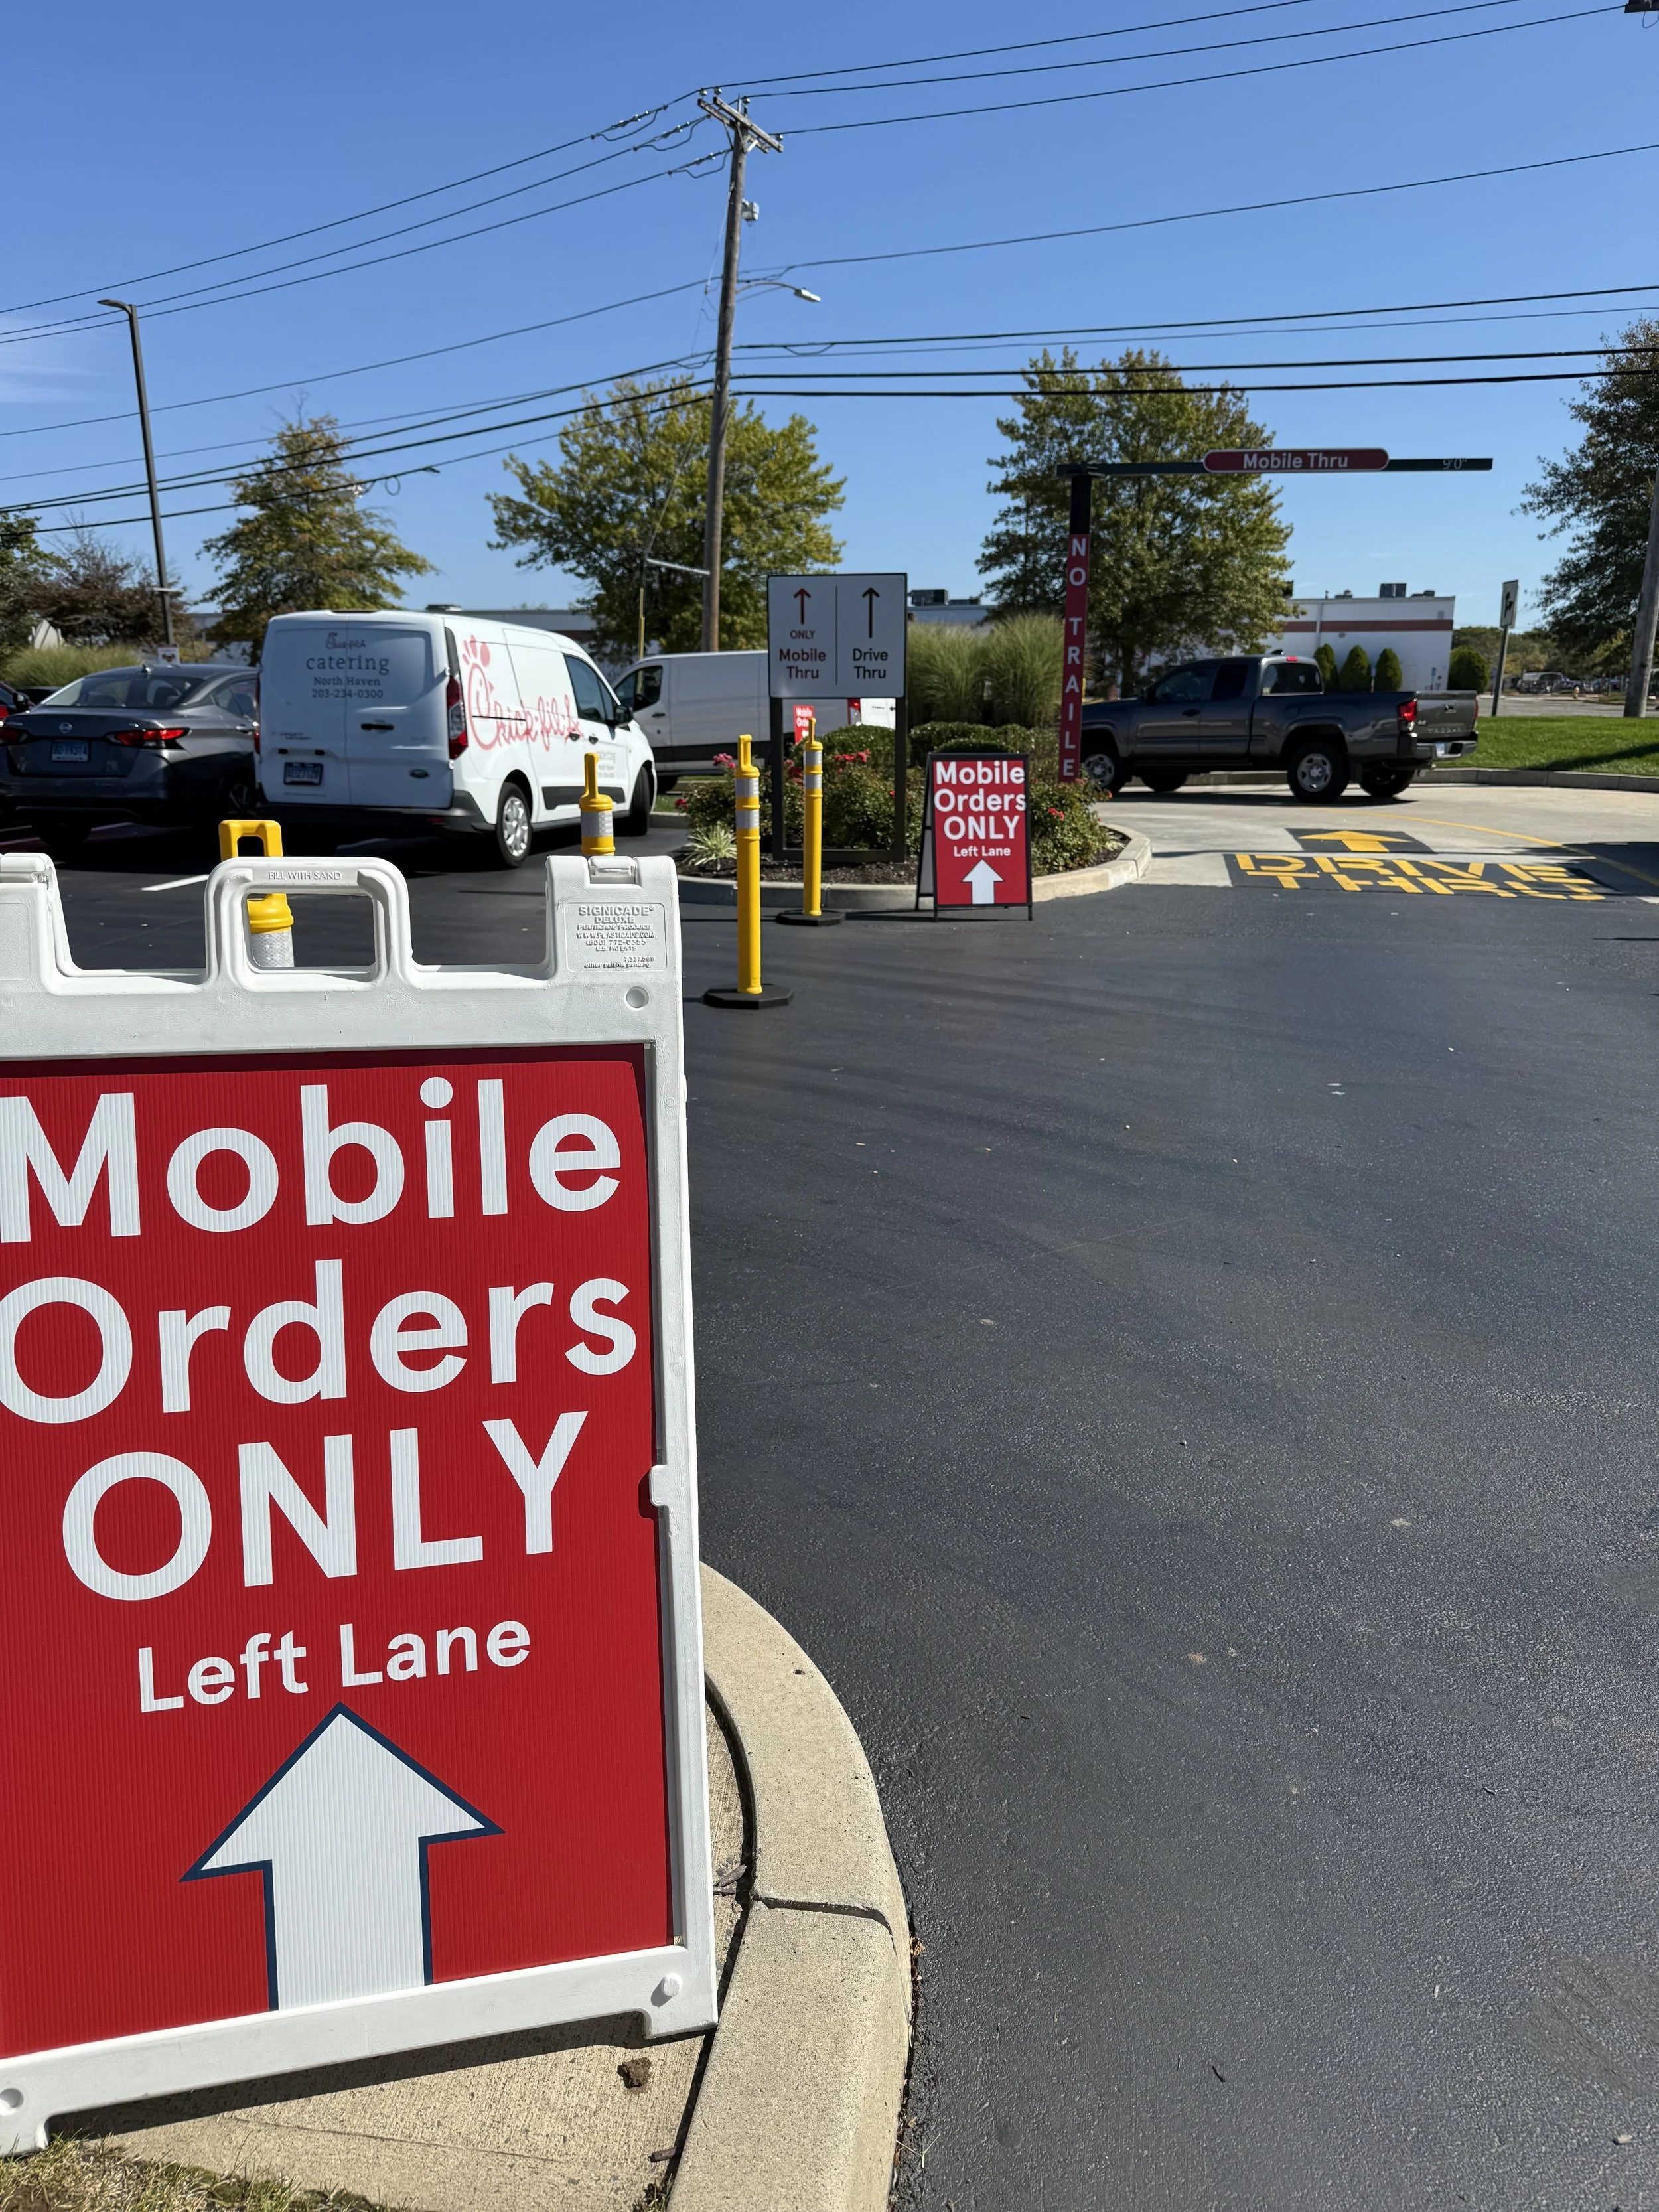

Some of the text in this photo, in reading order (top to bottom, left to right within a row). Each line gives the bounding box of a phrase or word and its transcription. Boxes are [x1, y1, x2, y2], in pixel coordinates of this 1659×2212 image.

[1243, 451, 1348, 470] Mobile Thru
[1069, 538, 1087, 587] NO
[790, 630, 815, 640] ONLY
[306, 654, 390, 676] catering
[779, 648, 826, 662] Mobile
[853, 648, 888, 662] Drive
[313, 676, 380, 686] North Haven
[786, 666, 819, 679] Thru
[854, 666, 886, 679] Thru
[312, 688, 384, 699] 203-234-0300
[936, 761, 1025, 785] Mobile
[934, 788, 1027, 812] Orders
[944, 815, 1020, 840] ONLY
[954, 845, 1011, 857] Left Lane
[268, 870, 342, 880] FILL WITH SAND
[1235, 853, 1596, 884] DRIVE
[1246, 871, 1606, 902] THRU
[0, 1076, 621, 1243] Mobile
[0, 1258, 636, 1424] Orders
[62, 1410, 589, 1601] ONLY
[138, 1620, 530, 1713] Left Lane
